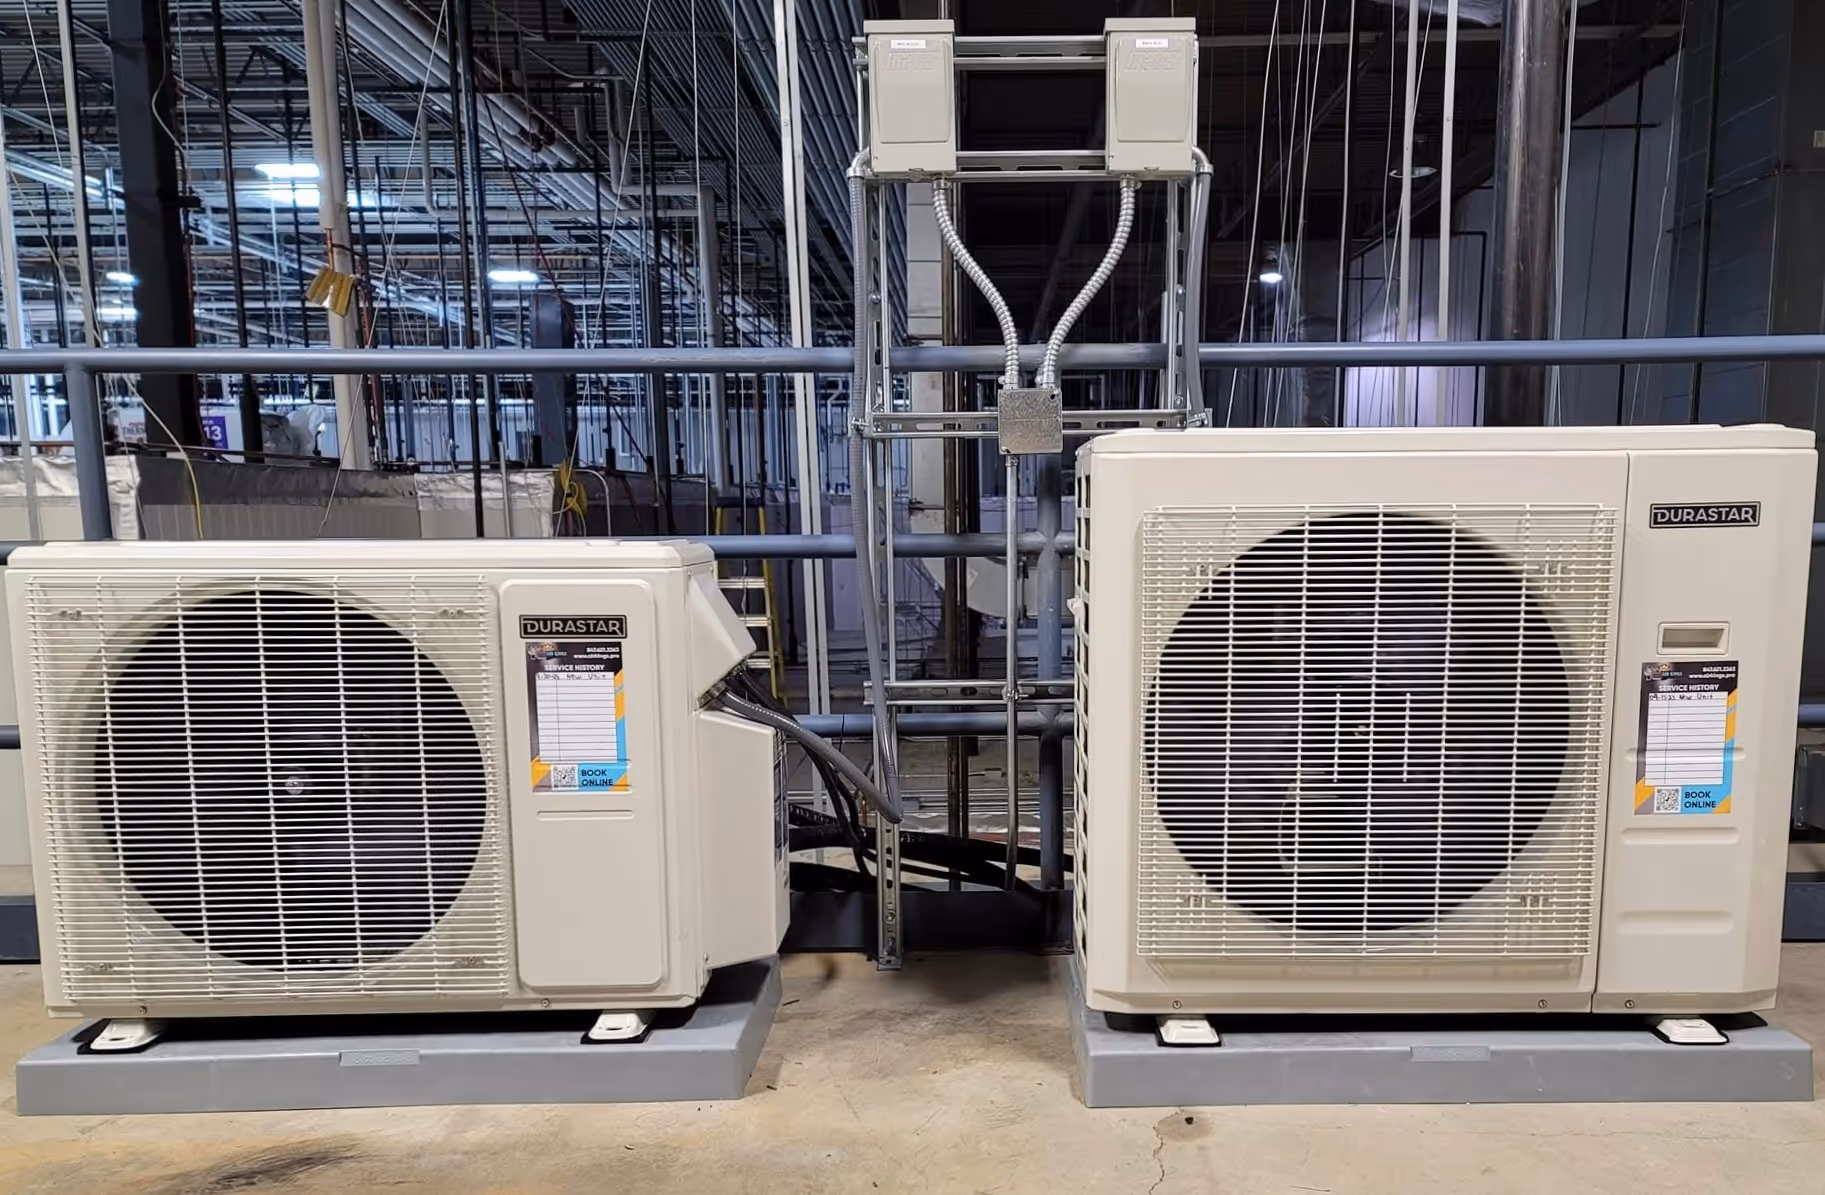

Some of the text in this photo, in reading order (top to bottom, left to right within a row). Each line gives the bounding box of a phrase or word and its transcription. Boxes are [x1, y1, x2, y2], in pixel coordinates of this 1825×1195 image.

[203, 425, 222, 441] 13
[1653, 507, 1754, 524] DURASTAR
[523, 619, 623, 636] DURASTAR
[1658, 683, 1719, 692] SERVICE HISTORY
[581, 769, 607, 777] BOOK
[581, 778, 614, 786] ONLINE
[1685, 791, 1711, 799] BOOK
[1684, 801, 1716, 809] ONLINE
